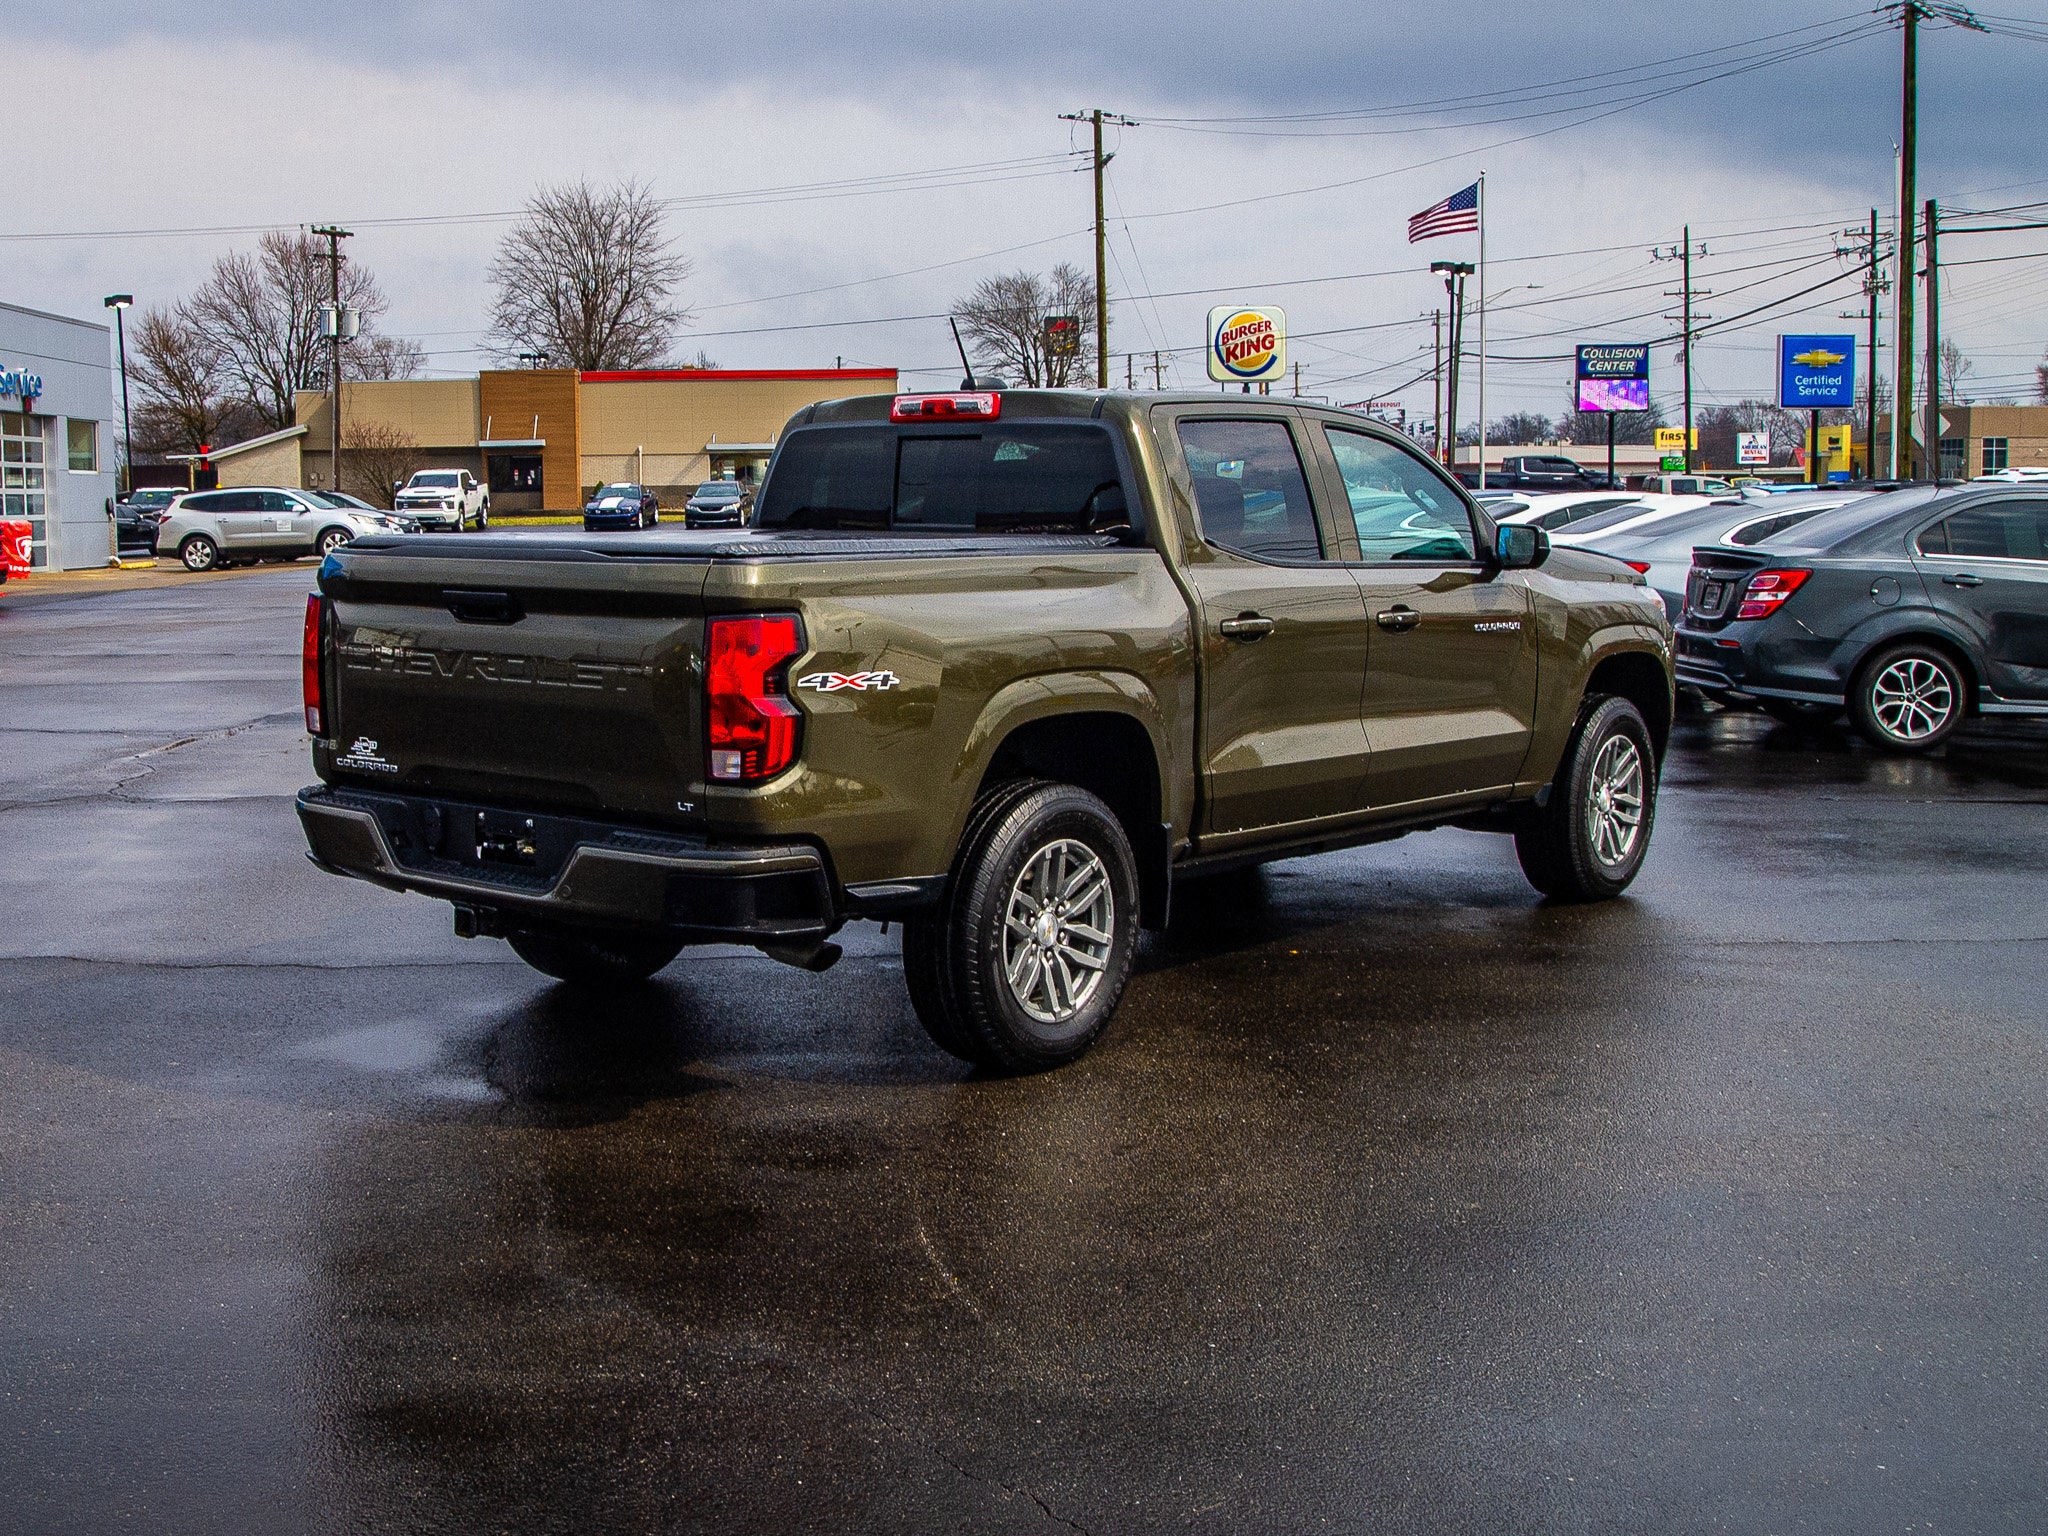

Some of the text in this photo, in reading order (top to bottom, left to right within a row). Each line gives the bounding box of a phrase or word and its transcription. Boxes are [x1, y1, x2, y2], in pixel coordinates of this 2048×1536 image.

[1221, 320, 1273, 346] BURGER
[1225, 333, 1275, 364] KING
[1581, 348, 1645, 359] COLLISION
[1587, 360, 1636, 372] CENTER
[1795, 375, 1842, 386] Certified
[1798, 385, 1838, 396] Service
[337, 645, 654, 692] CHEVROLET
[336, 757, 398, 773] COLORADO
[677, 801, 694, 812] LT
